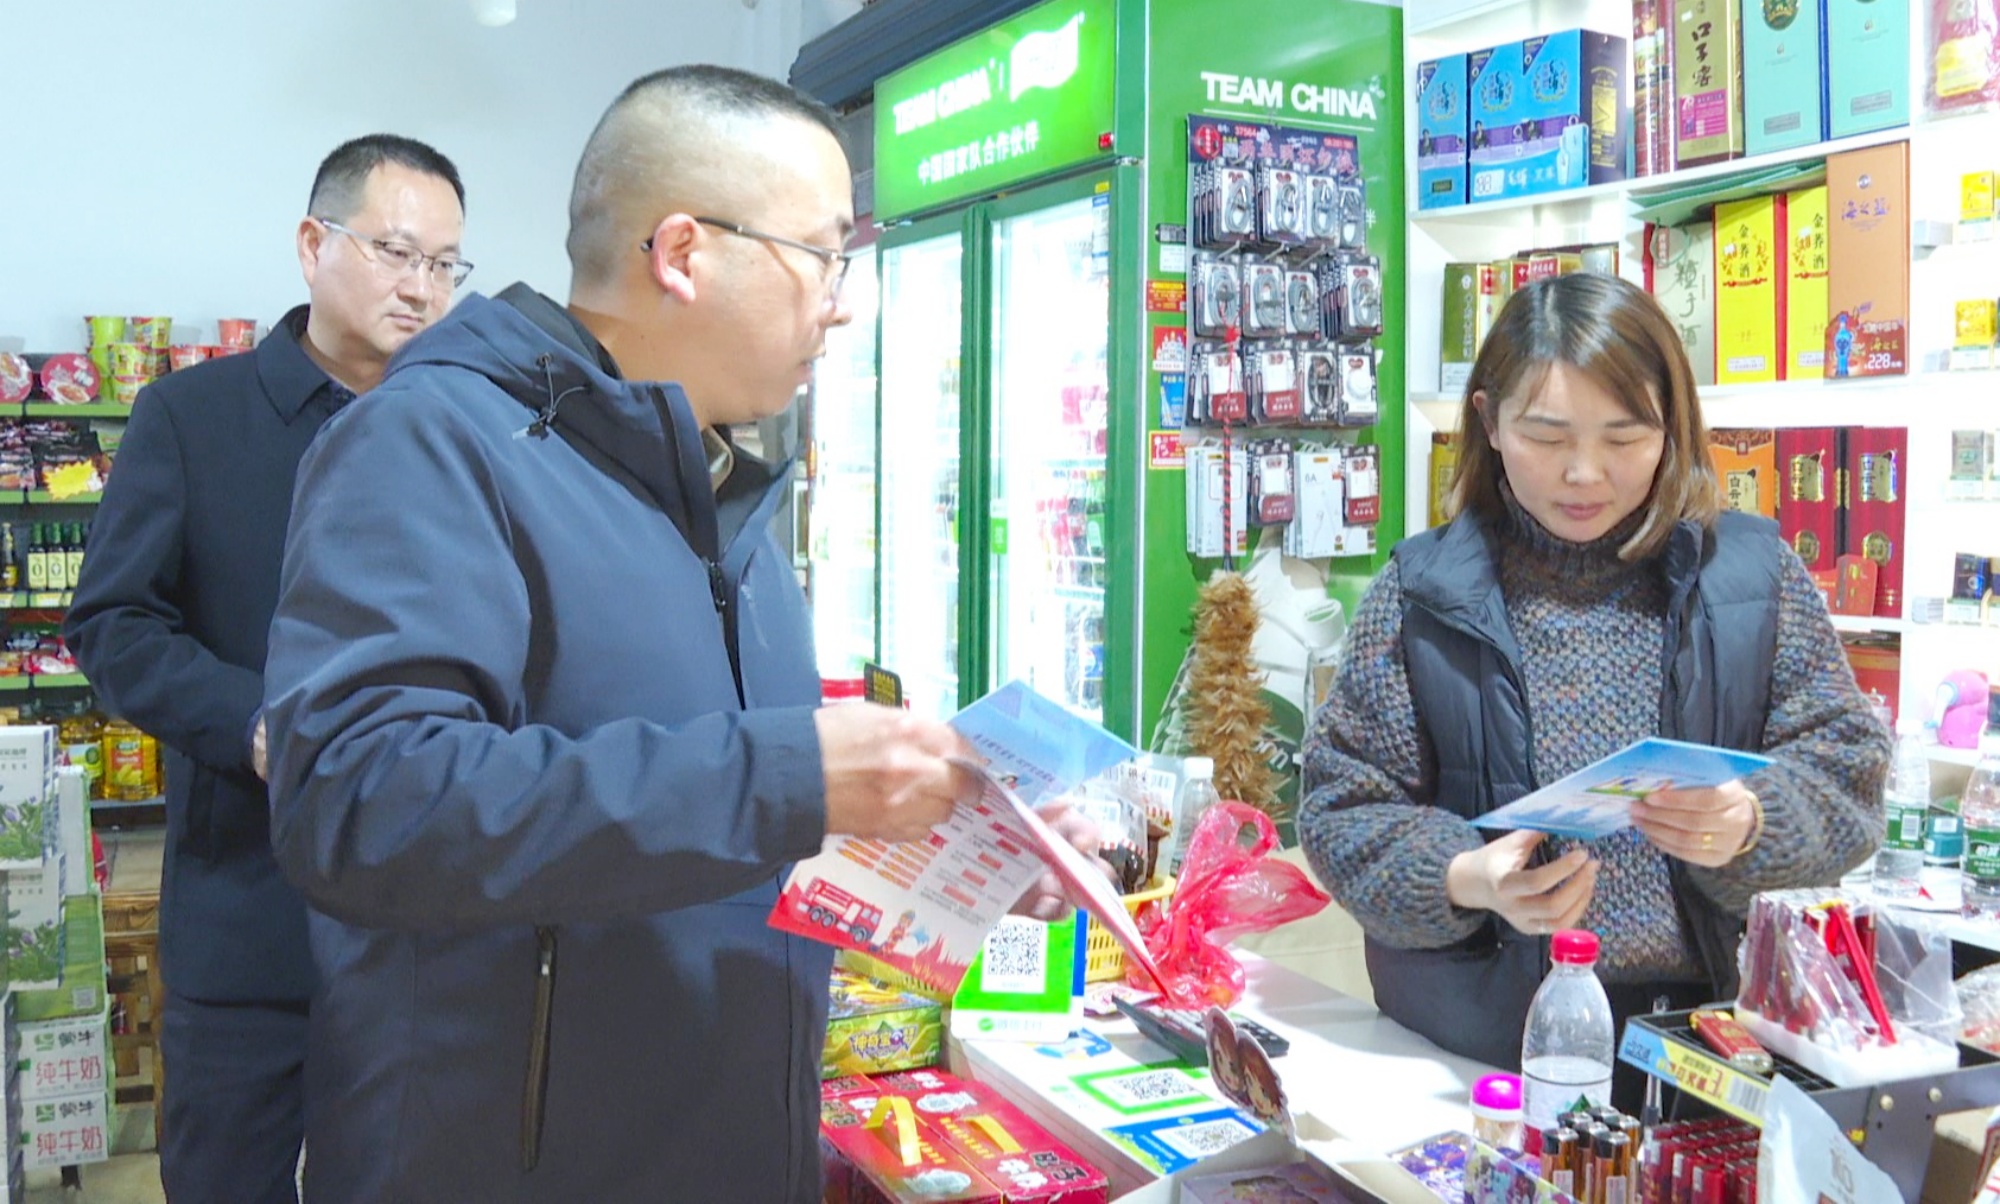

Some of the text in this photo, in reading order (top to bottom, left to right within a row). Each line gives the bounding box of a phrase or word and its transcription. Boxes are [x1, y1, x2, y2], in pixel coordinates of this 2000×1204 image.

[1200, 71, 1377, 121] TEAM CHINA
[35, 1056, 101, 1086] 纯牛奶
[36, 1126, 102, 1157] 纯牛奶
